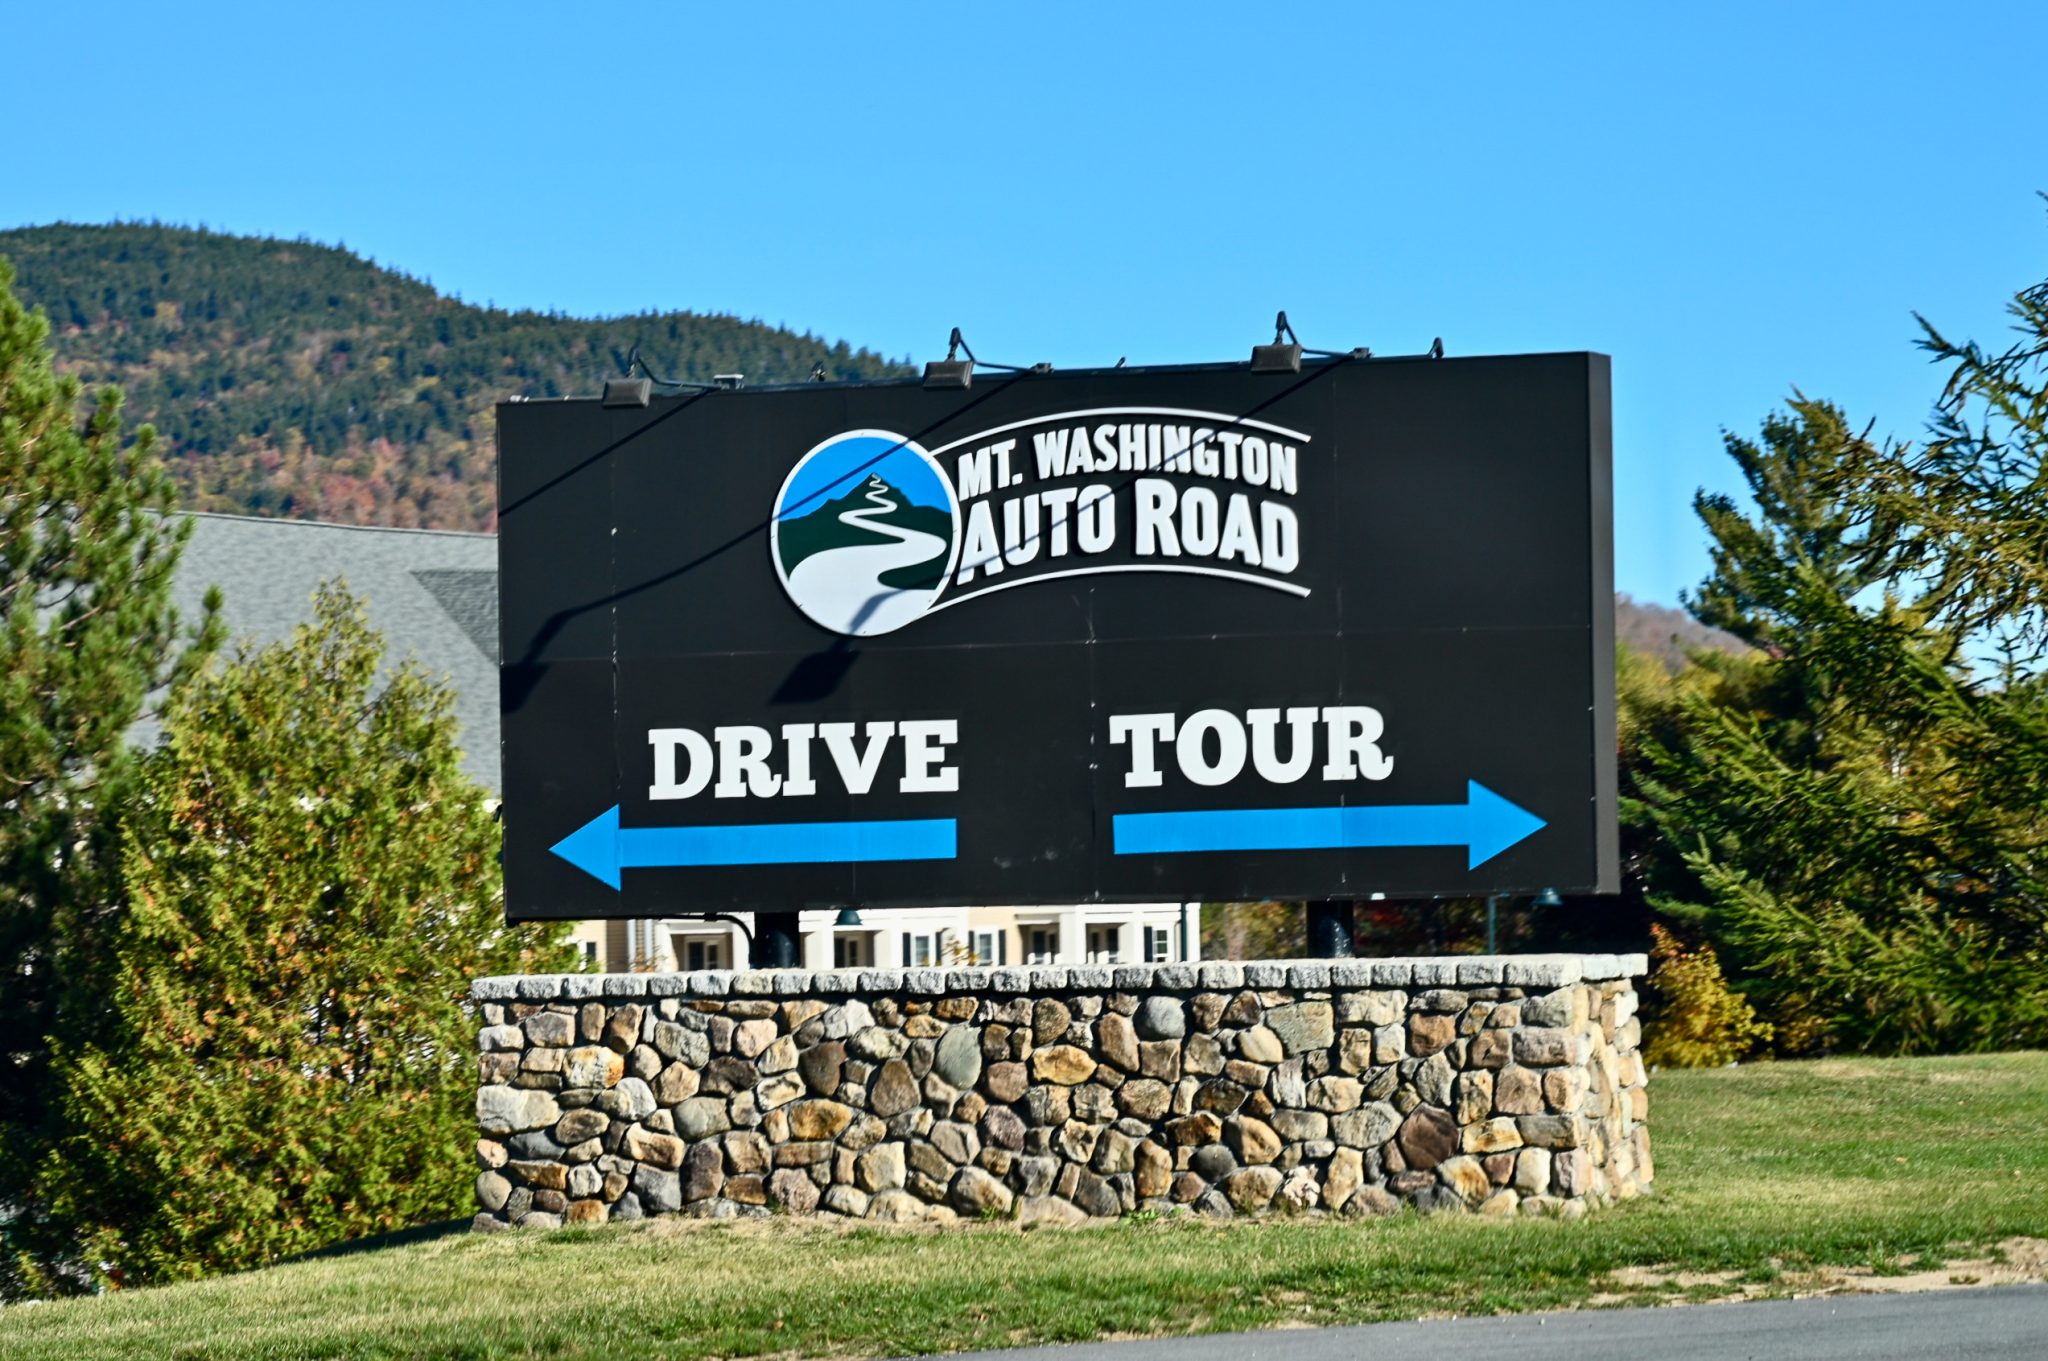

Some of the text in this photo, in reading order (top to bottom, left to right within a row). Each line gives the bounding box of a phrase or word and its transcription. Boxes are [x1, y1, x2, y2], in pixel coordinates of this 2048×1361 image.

[957, 424, 1299, 502] MT. WASHINGTON
[956, 478, 1300, 586] AUTO ROAD
[648, 719, 960, 802] DRIVE
[1108, 706, 1394, 789] TOUR
